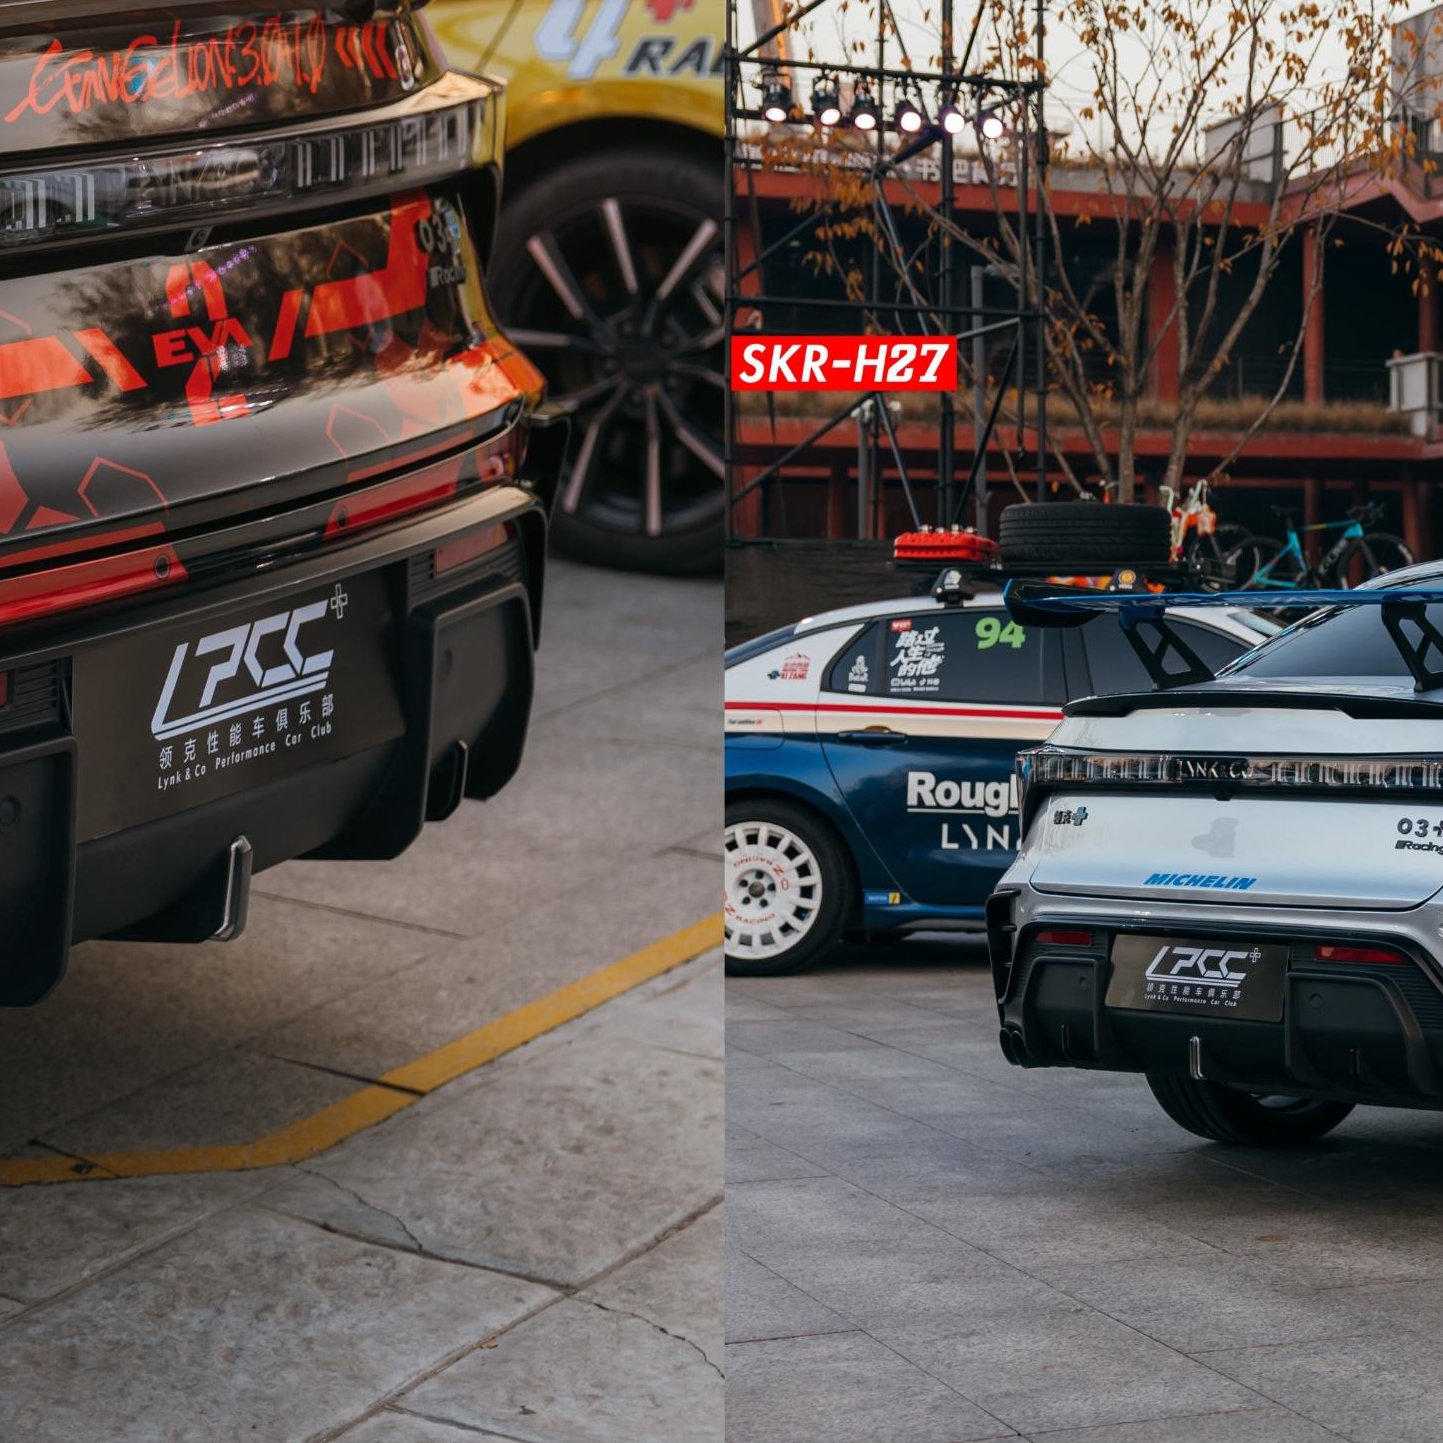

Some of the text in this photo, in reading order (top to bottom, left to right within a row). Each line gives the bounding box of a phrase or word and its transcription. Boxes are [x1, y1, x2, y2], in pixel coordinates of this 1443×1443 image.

[152, 318, 254, 368] EVA
[975, 617, 1026, 650] 94
[159, 693, 334, 770] 领克性能车俱乐部
[157, 722, 332, 791] Lynk & Co Performance Car Club
[941, 823, 1022, 851] LYN
[1143, 873, 1257, 890] MICHELIN
[1174, 995, 1207, 1005] Performance
